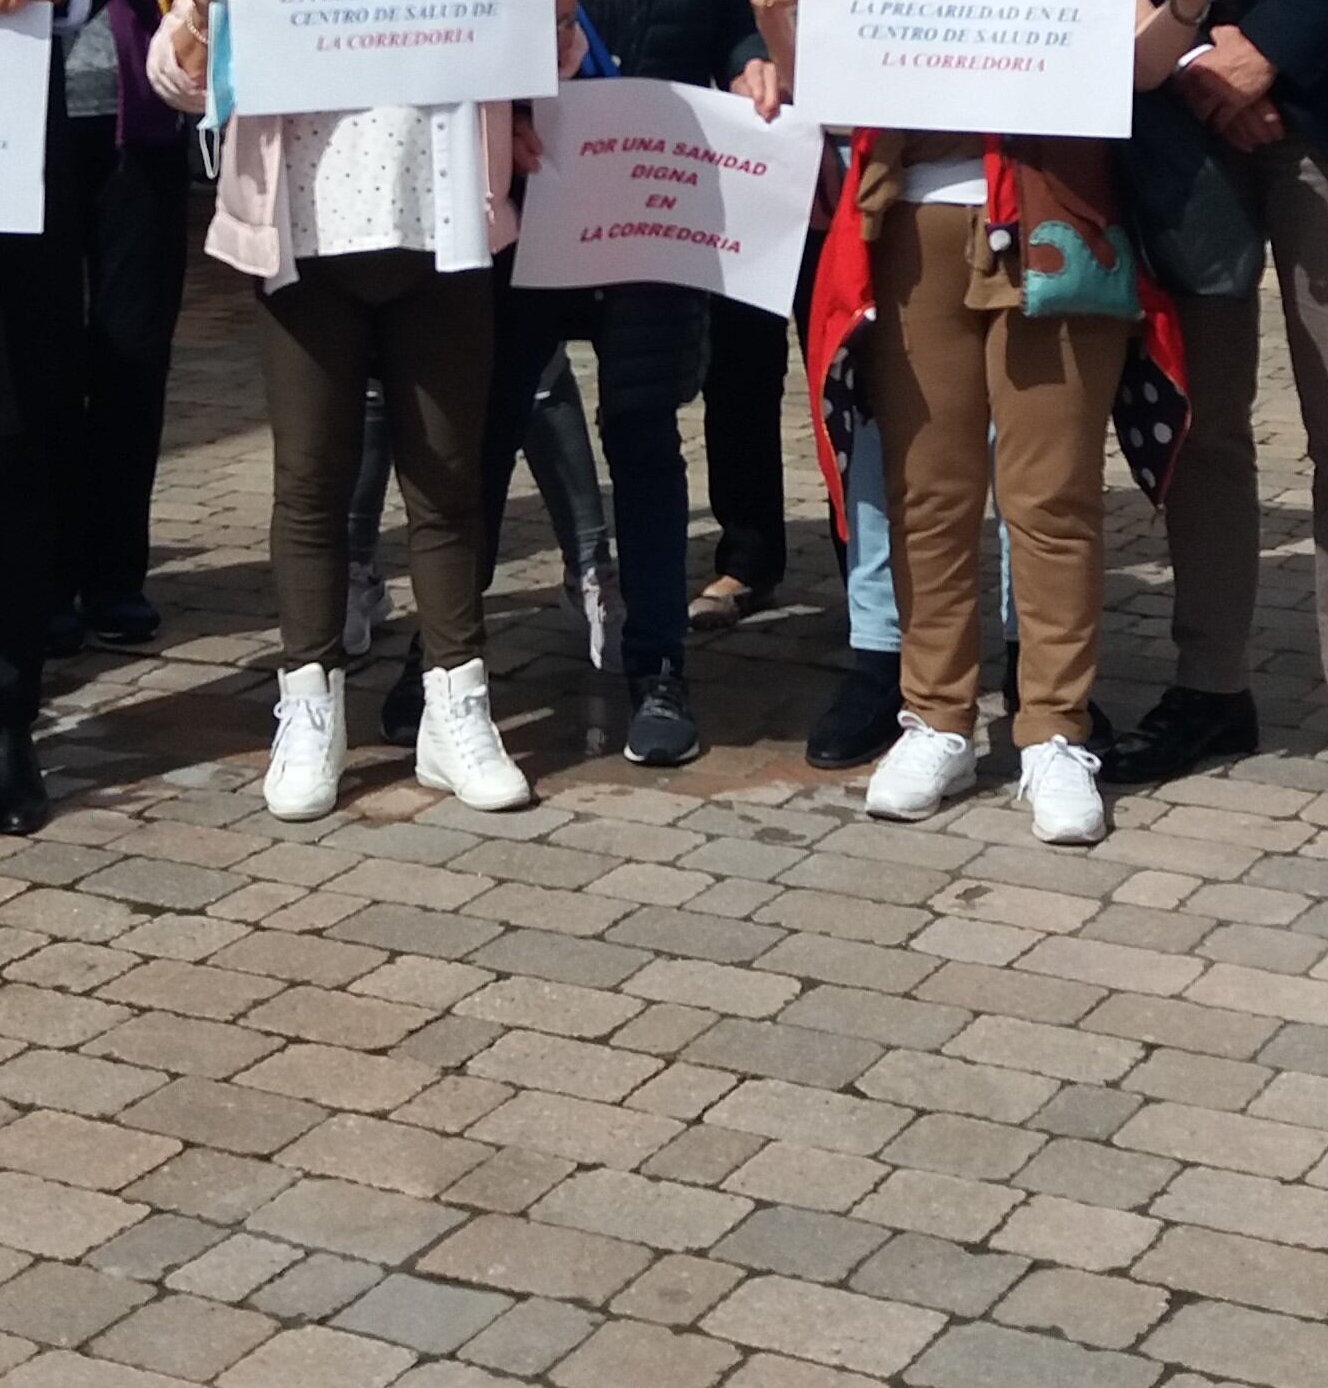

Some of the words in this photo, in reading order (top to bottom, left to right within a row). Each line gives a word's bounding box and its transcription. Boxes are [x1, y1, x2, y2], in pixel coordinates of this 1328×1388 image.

[289, 8, 369, 26] CENTRO
[373, 5, 400, 22] DE
[405, 4, 468, 21] SALUD
[472, 1, 500, 17] DE
[850, 0, 874, 14] LA
[880, 1, 1019, 20] PRECARIEDAD
[1024, 5, 1053, 21] EN
[1057, 7, 1082, 23] EL
[316, 36, 341, 51] LA
[346, 28, 474, 50] CORREDORIA
[858, 24, 938, 42] CENTRO
[942, 27, 970, 43] DE
[974, 29, 1040, 45] SALUD
[1044, 30, 1074, 47] DE
[881, 51, 906, 68] LA
[913, 52, 1046, 72] CORREDORIA
[580, 138, 618, 156] POR
[621, 137, 667, 154] UNA
[672, 142, 767, 176] SANIDAD
[631, 164, 698, 187] DIGNA
[645, 193, 677, 210] EN
[580, 226, 603, 243] LA
[607, 221, 741, 254] CORREDORIA
